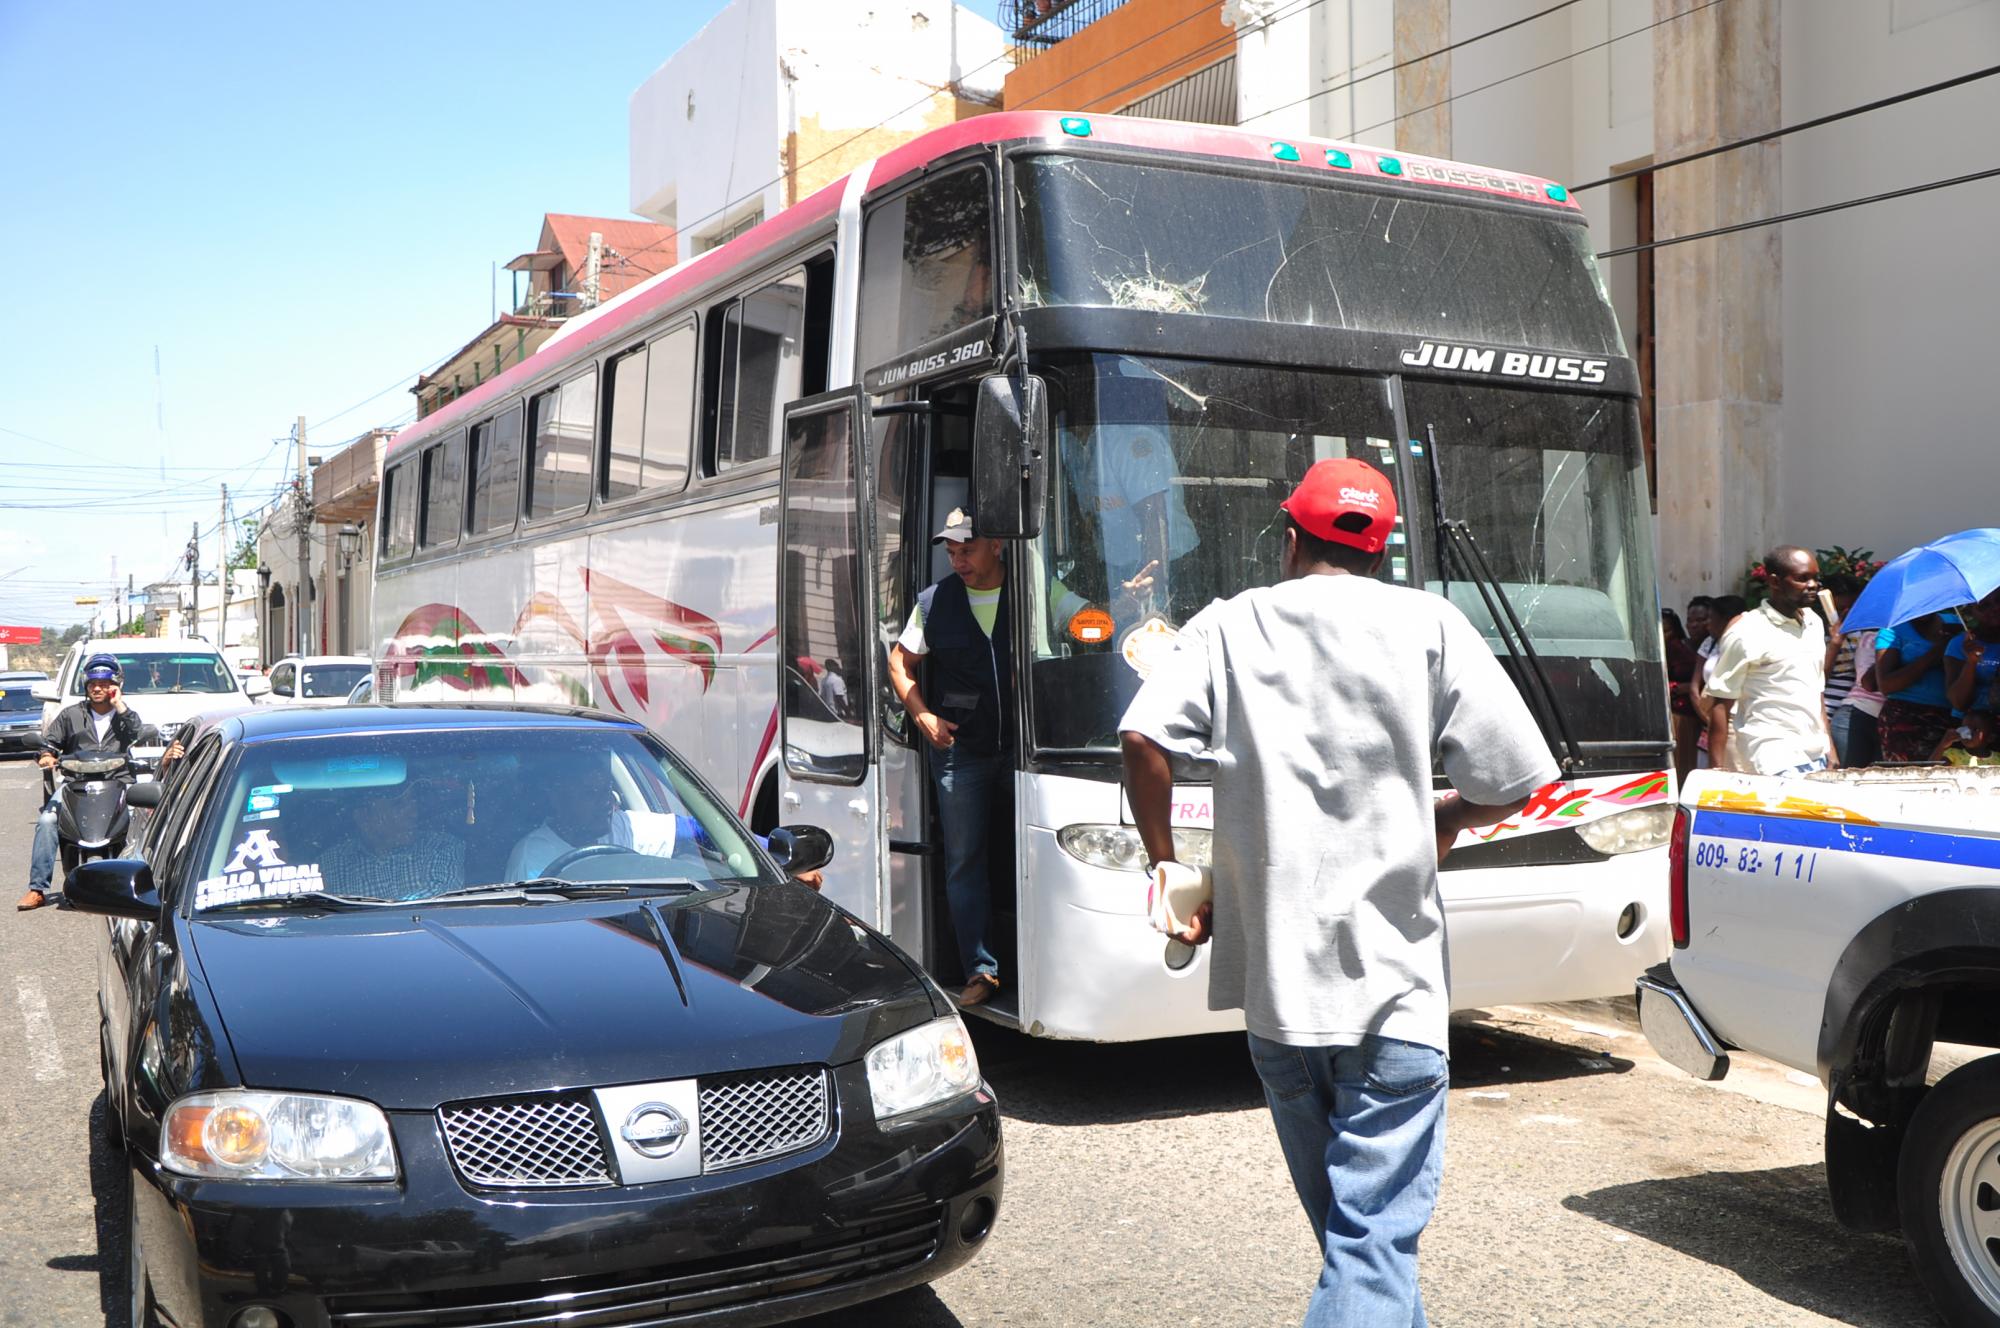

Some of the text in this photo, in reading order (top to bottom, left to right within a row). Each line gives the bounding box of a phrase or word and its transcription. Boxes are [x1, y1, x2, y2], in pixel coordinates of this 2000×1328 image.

[878, 340, 984, 386] JUM BUSS 360
[1402, 343, 1608, 383] JUM BUSS
[1170, 802, 1211, 819] TRA
[259, 864, 322, 883] VIDAL
[264, 877, 324, 896] NUEVA
